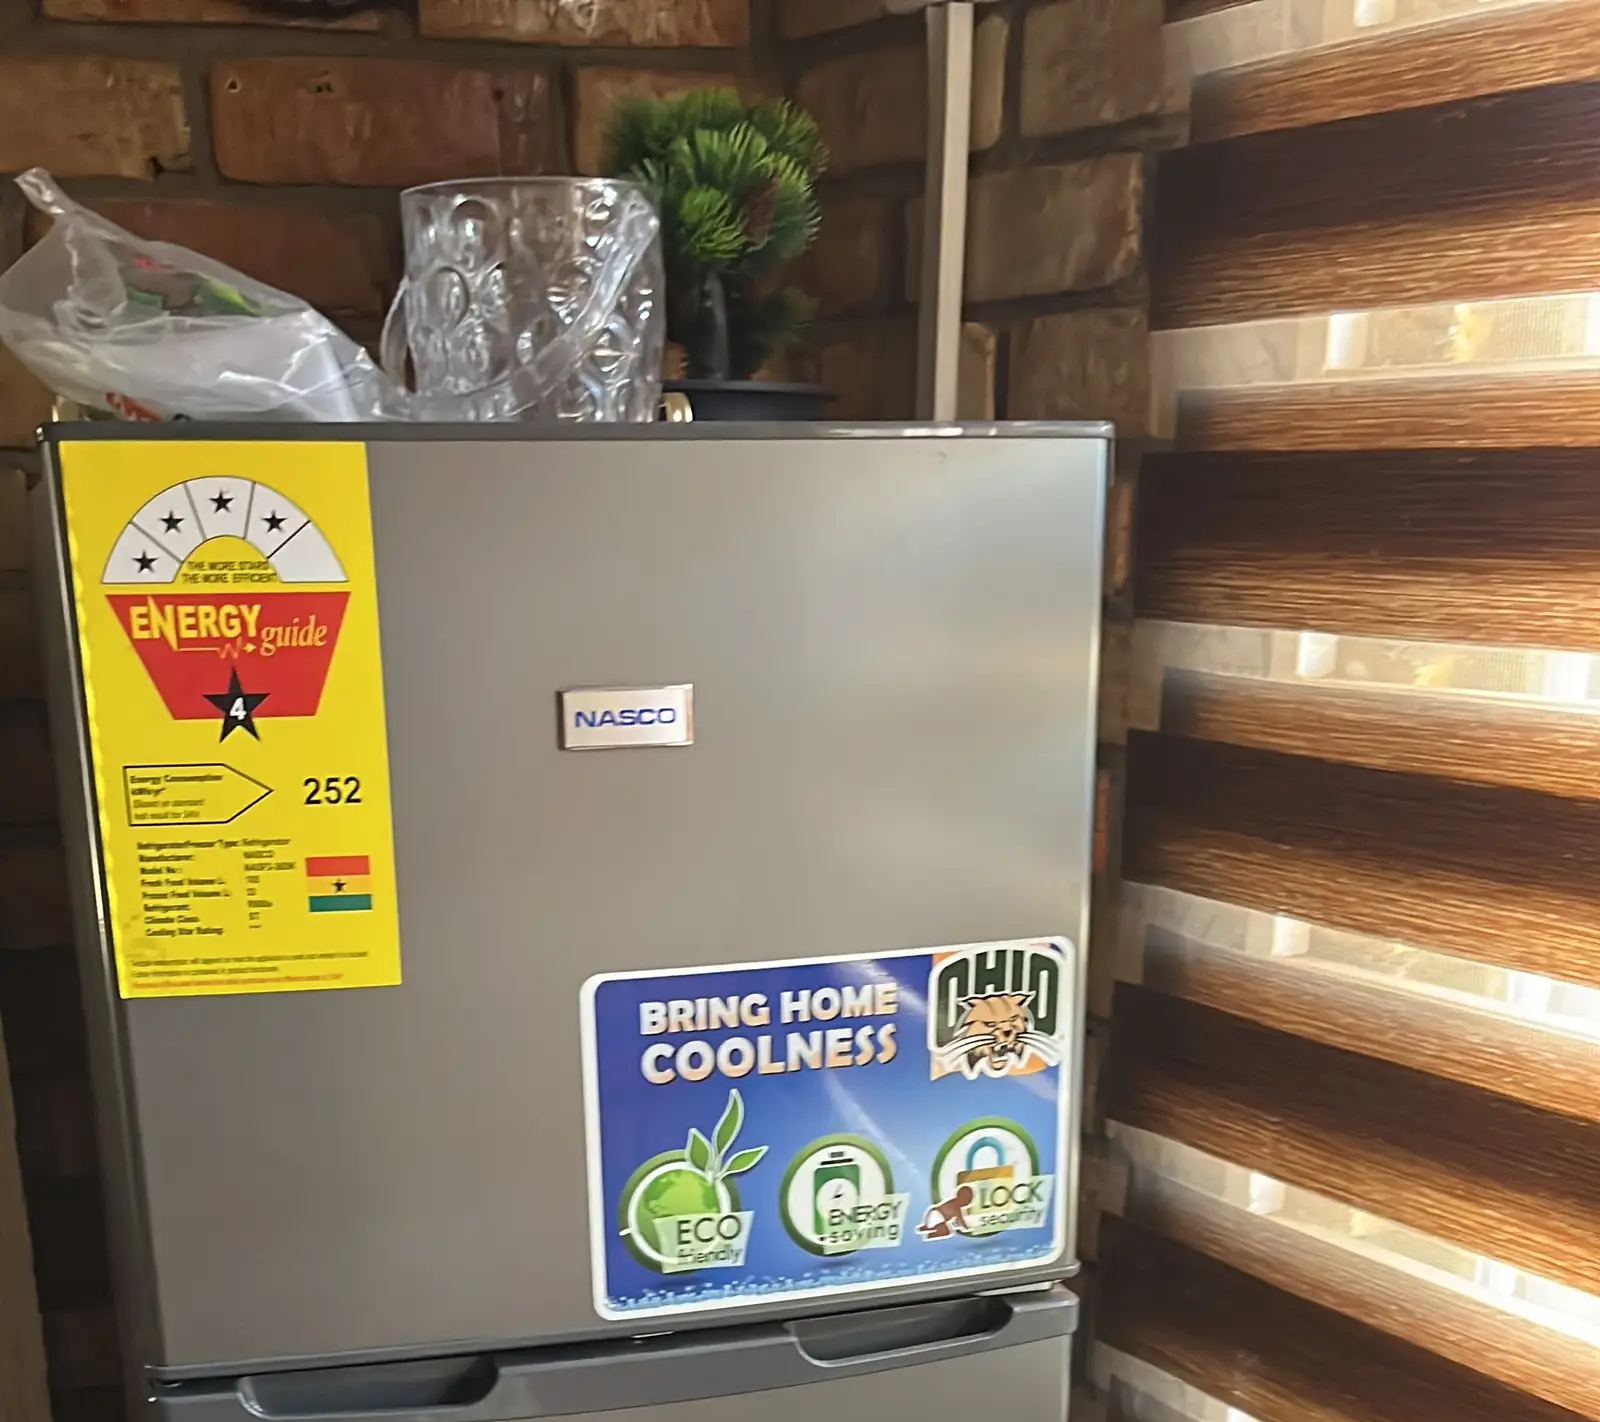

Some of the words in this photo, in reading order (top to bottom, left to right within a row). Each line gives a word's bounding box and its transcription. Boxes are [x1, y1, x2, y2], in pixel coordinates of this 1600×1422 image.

[129, 595, 262, 651] ENERGY
[259, 615, 328, 657] guide
[229, 697, 247, 721] 4
[575, 708, 676, 728] NASCO
[303, 776, 362, 805] 252
[639, 992, 771, 1035] BRING
[780, 982, 900, 1025] HOME
[936, 949, 1059, 1048] OHIO
[640, 1023, 898, 1085] COOLNESS
[980, 1180, 1044, 1209] LOCK
[829, 1200, 902, 1227] ENERGY
[677, 1214, 741, 1246] ECO
[831, 1222, 900, 1241] saving
[677, 1243, 743, 1265] friendly
